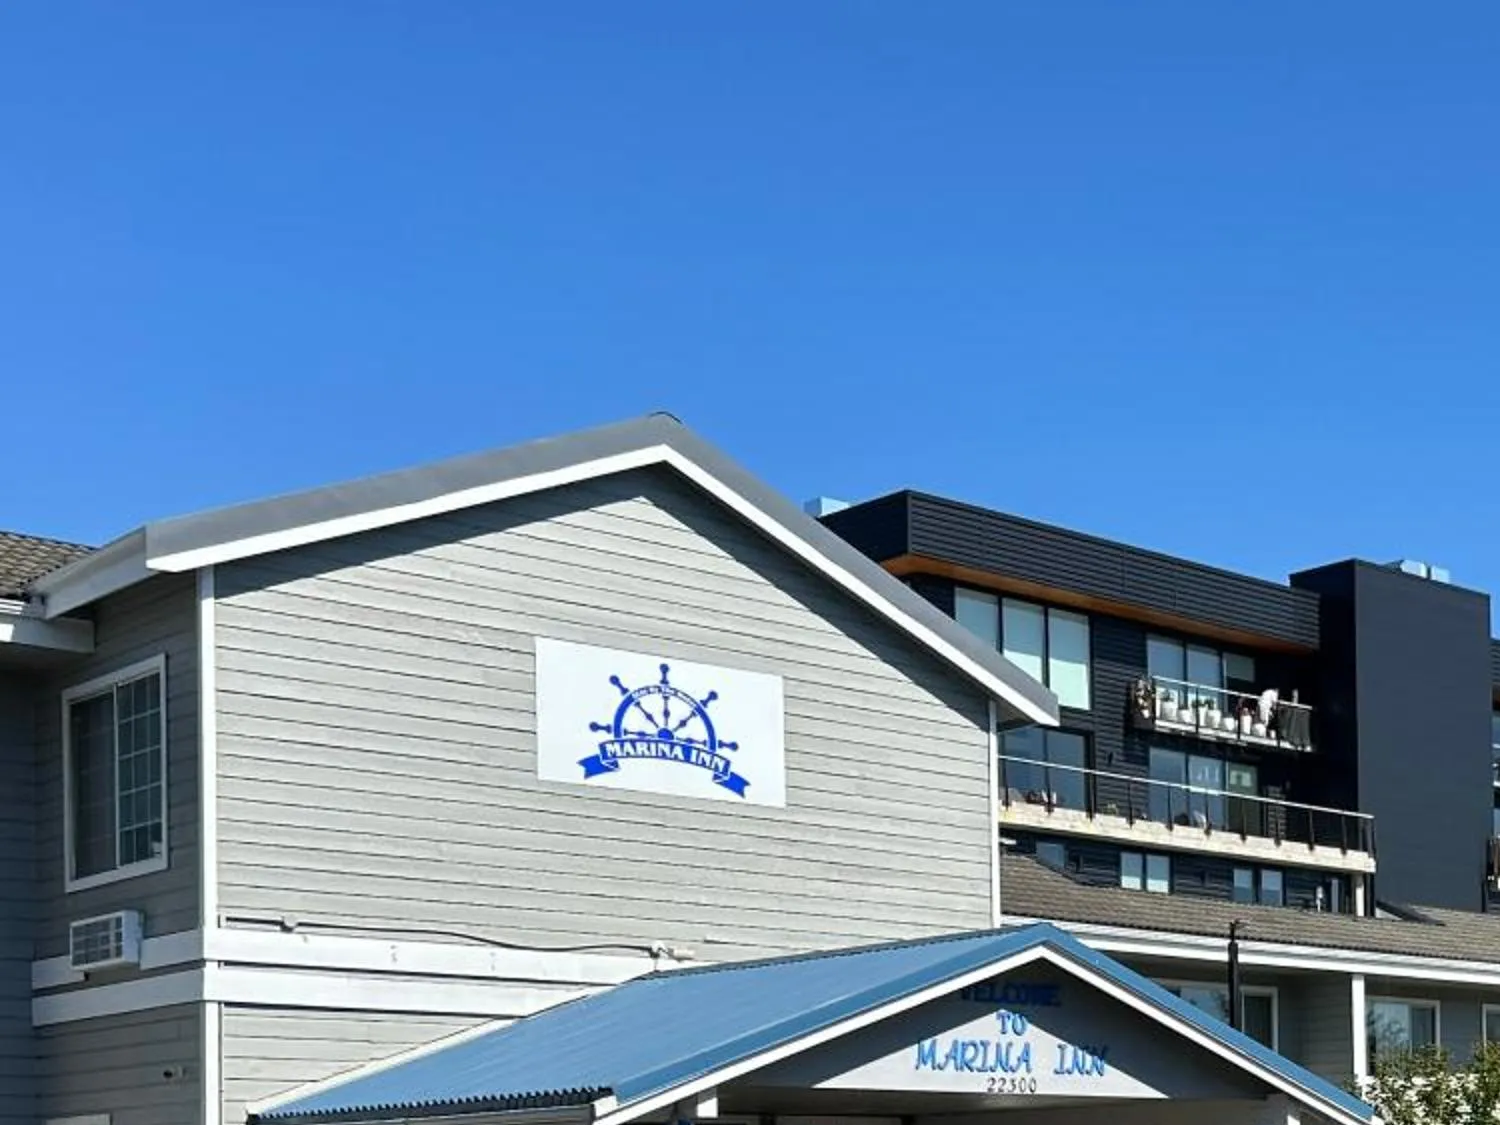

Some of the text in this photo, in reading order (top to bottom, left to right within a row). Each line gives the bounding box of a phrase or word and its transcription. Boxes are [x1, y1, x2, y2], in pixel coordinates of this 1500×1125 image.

[605, 741, 726, 773] MARINA INN
[996, 1011, 1027, 1036] TO
[915, 1038, 1108, 1076] MARINA INN
